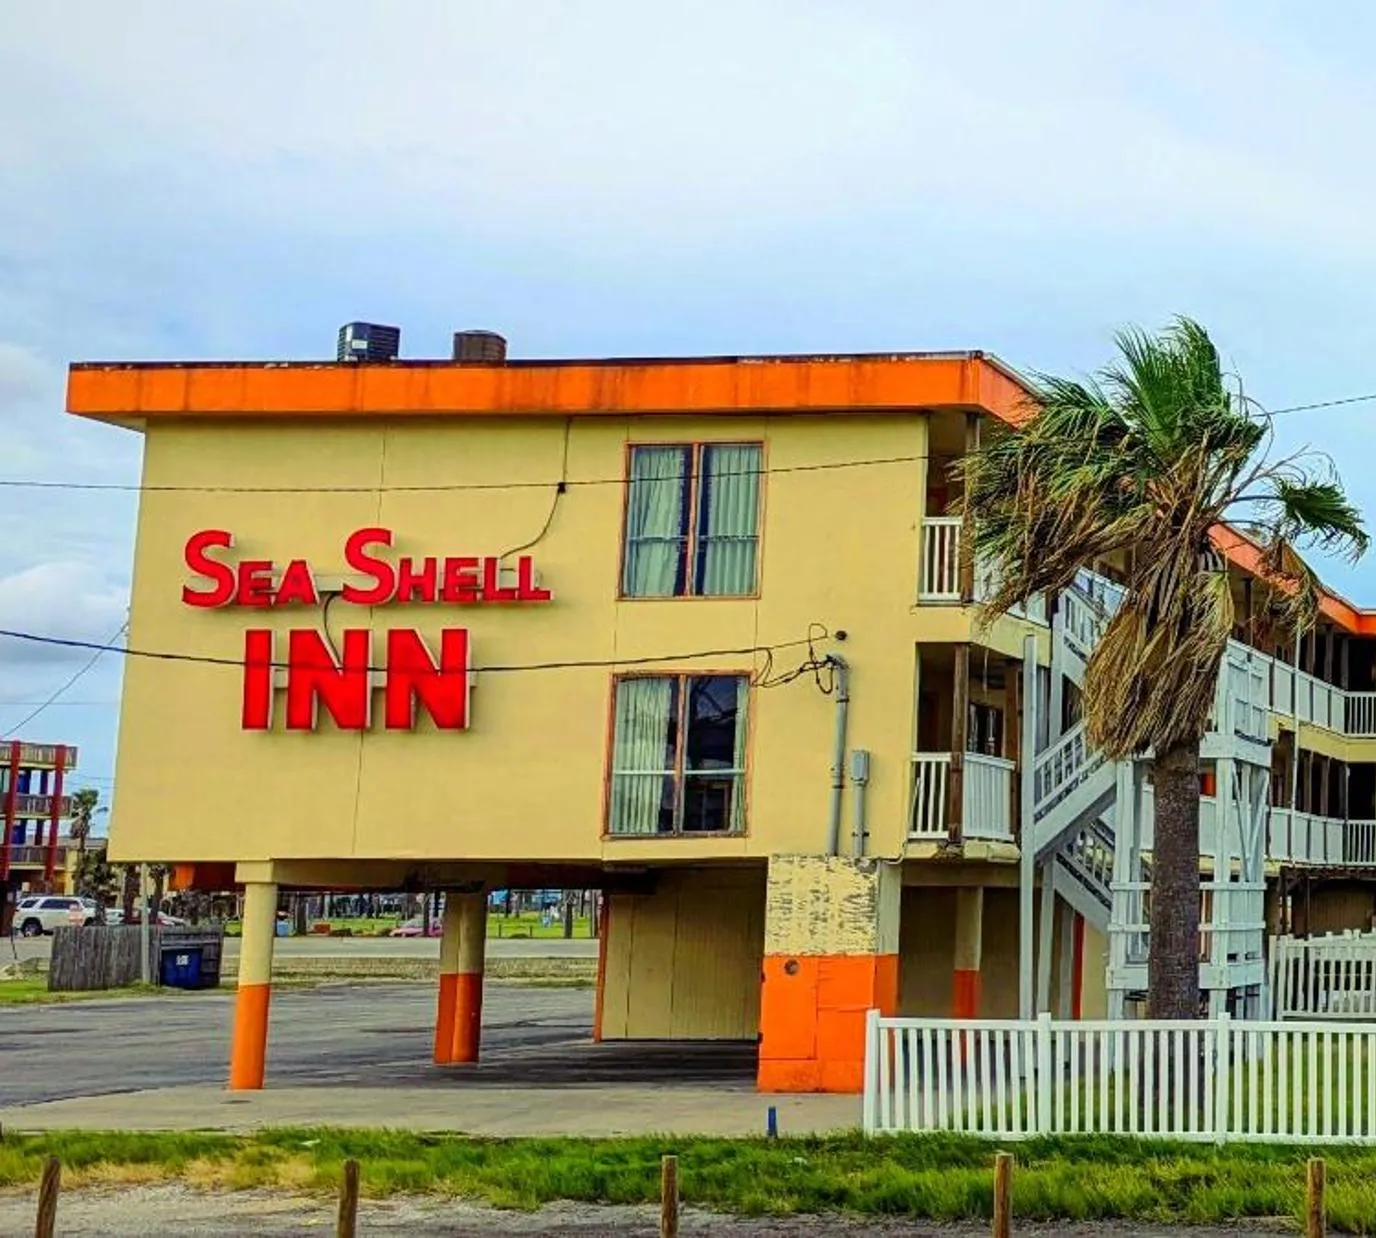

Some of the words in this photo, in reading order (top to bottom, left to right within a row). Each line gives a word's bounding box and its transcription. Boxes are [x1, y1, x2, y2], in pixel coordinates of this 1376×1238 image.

[182, 529, 319, 608] SEA
[341, 527, 553, 605] SHELL
[241, 628, 471, 732] INN
